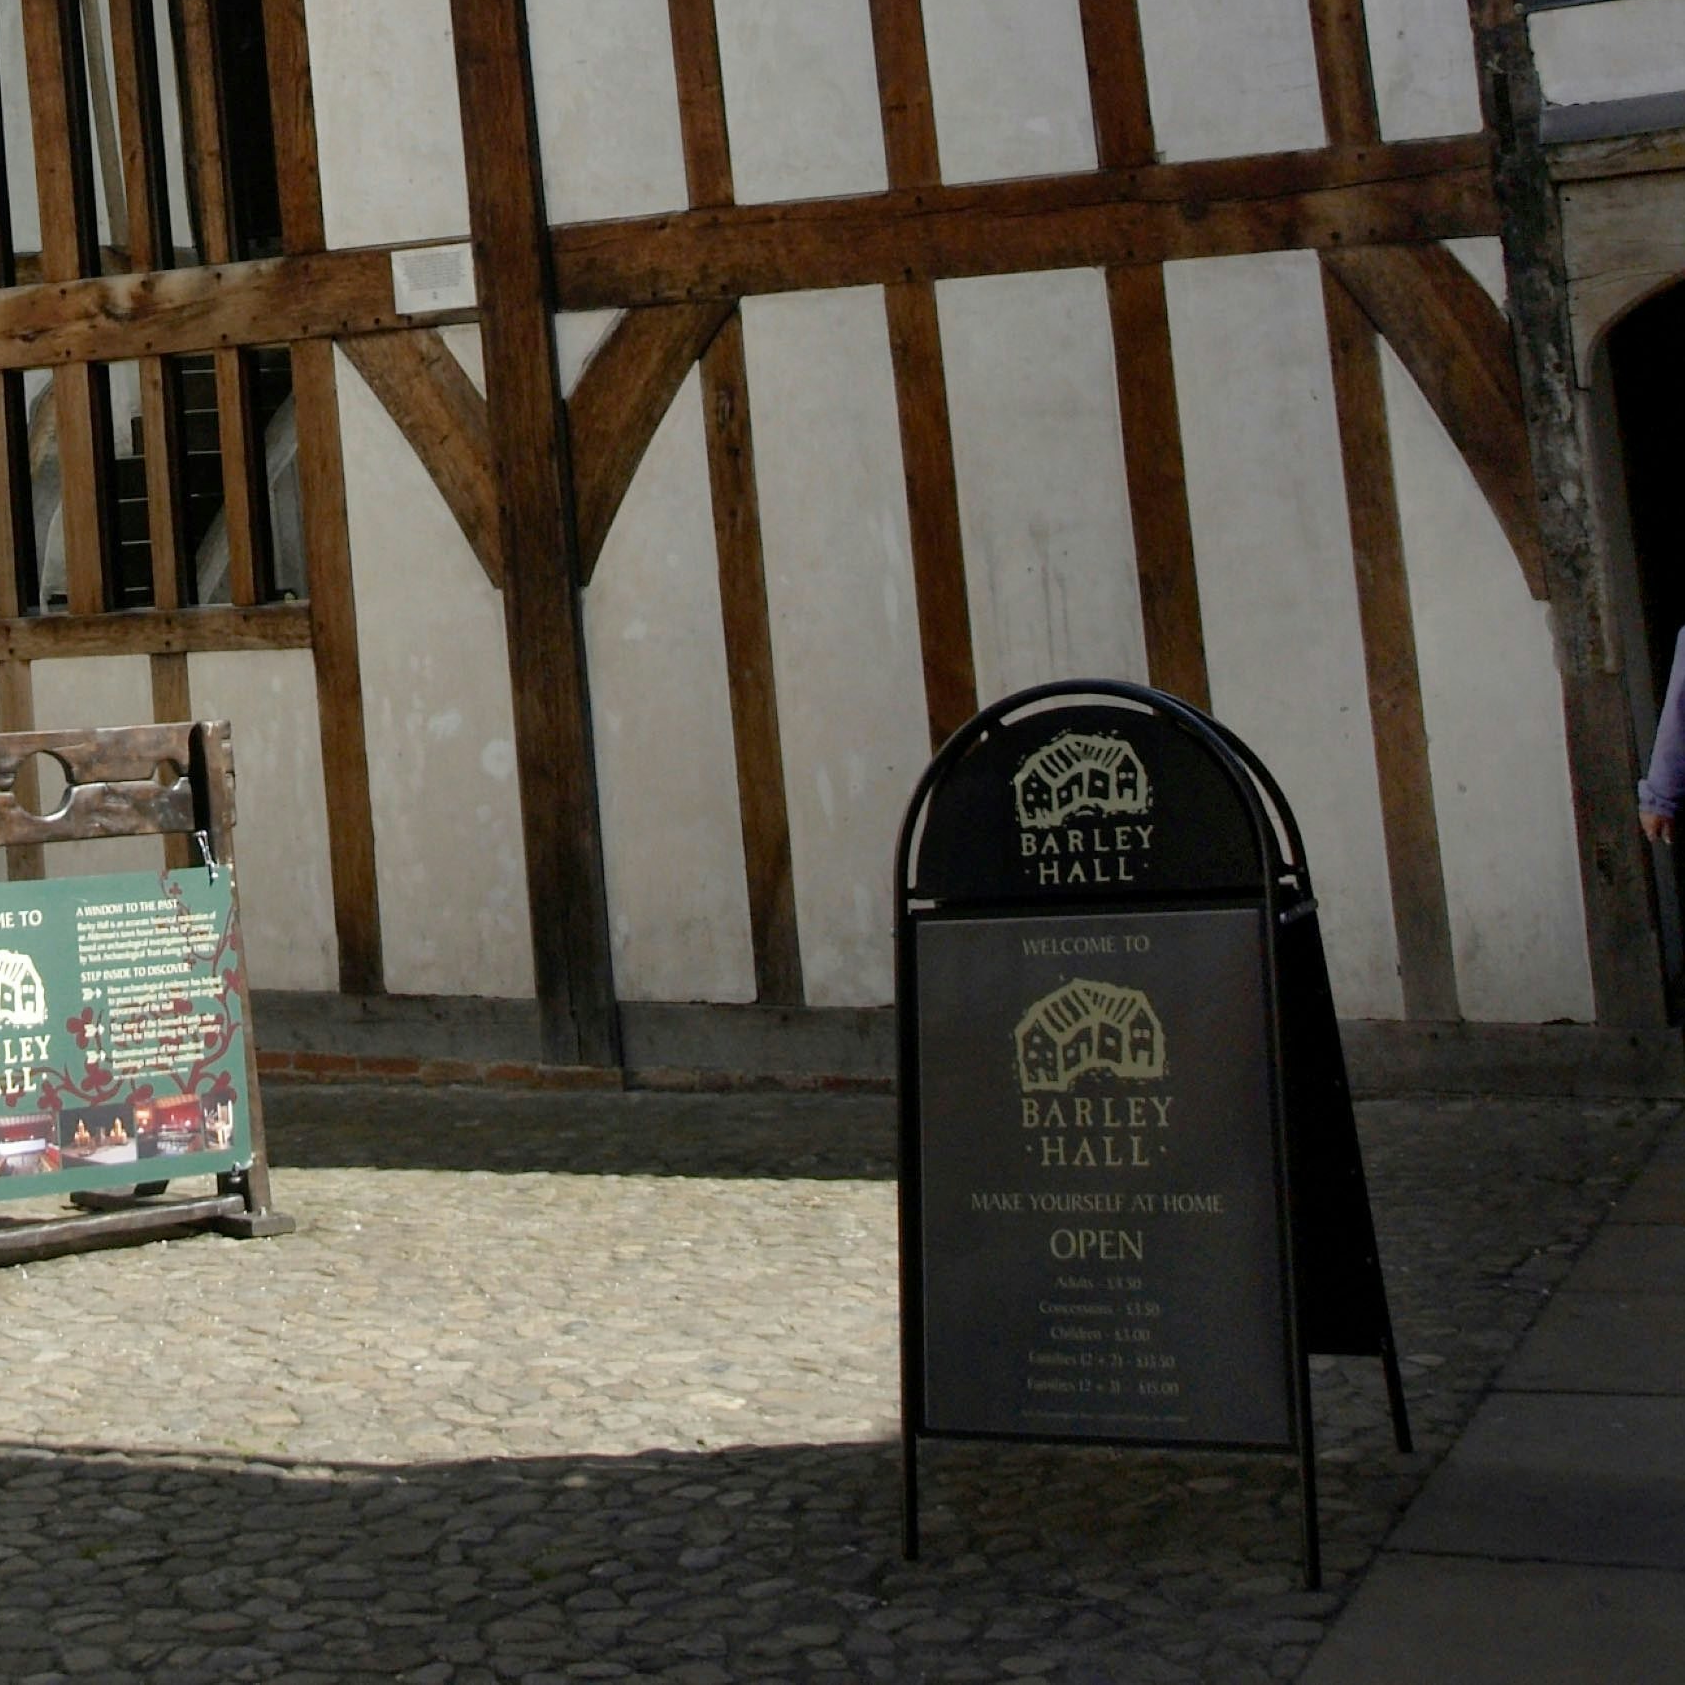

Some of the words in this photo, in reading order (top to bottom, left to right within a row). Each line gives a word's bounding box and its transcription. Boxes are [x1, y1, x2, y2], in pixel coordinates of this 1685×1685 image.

[1022, 826, 1153, 856] BARLEY
[76, 907, 83, 916] A
[84, 903, 123, 916] WINDOW
[126, 903, 138, 913] TO
[139, 901, 156, 911] THE
[158, 899, 178, 909] PAST
[18, 910, 43, 927] TO
[1023, 937, 1116, 956] WELCOME
[1123, 935, 1150, 952] TO
[81, 971, 101, 982] STEP
[104, 969, 131, 980] INSIDE
[134, 967, 146, 977] TO
[1022, 1096, 1173, 1129] BARLEY
[971, 1193, 1023, 1211] MAKE
[1029, 1193, 1124, 1212] YOURSELF
[1131, 1194, 1157, 1212] AT
[1163, 1194, 1225, 1213] HOME
[1050, 1228, 1143, 1260] OPEN
